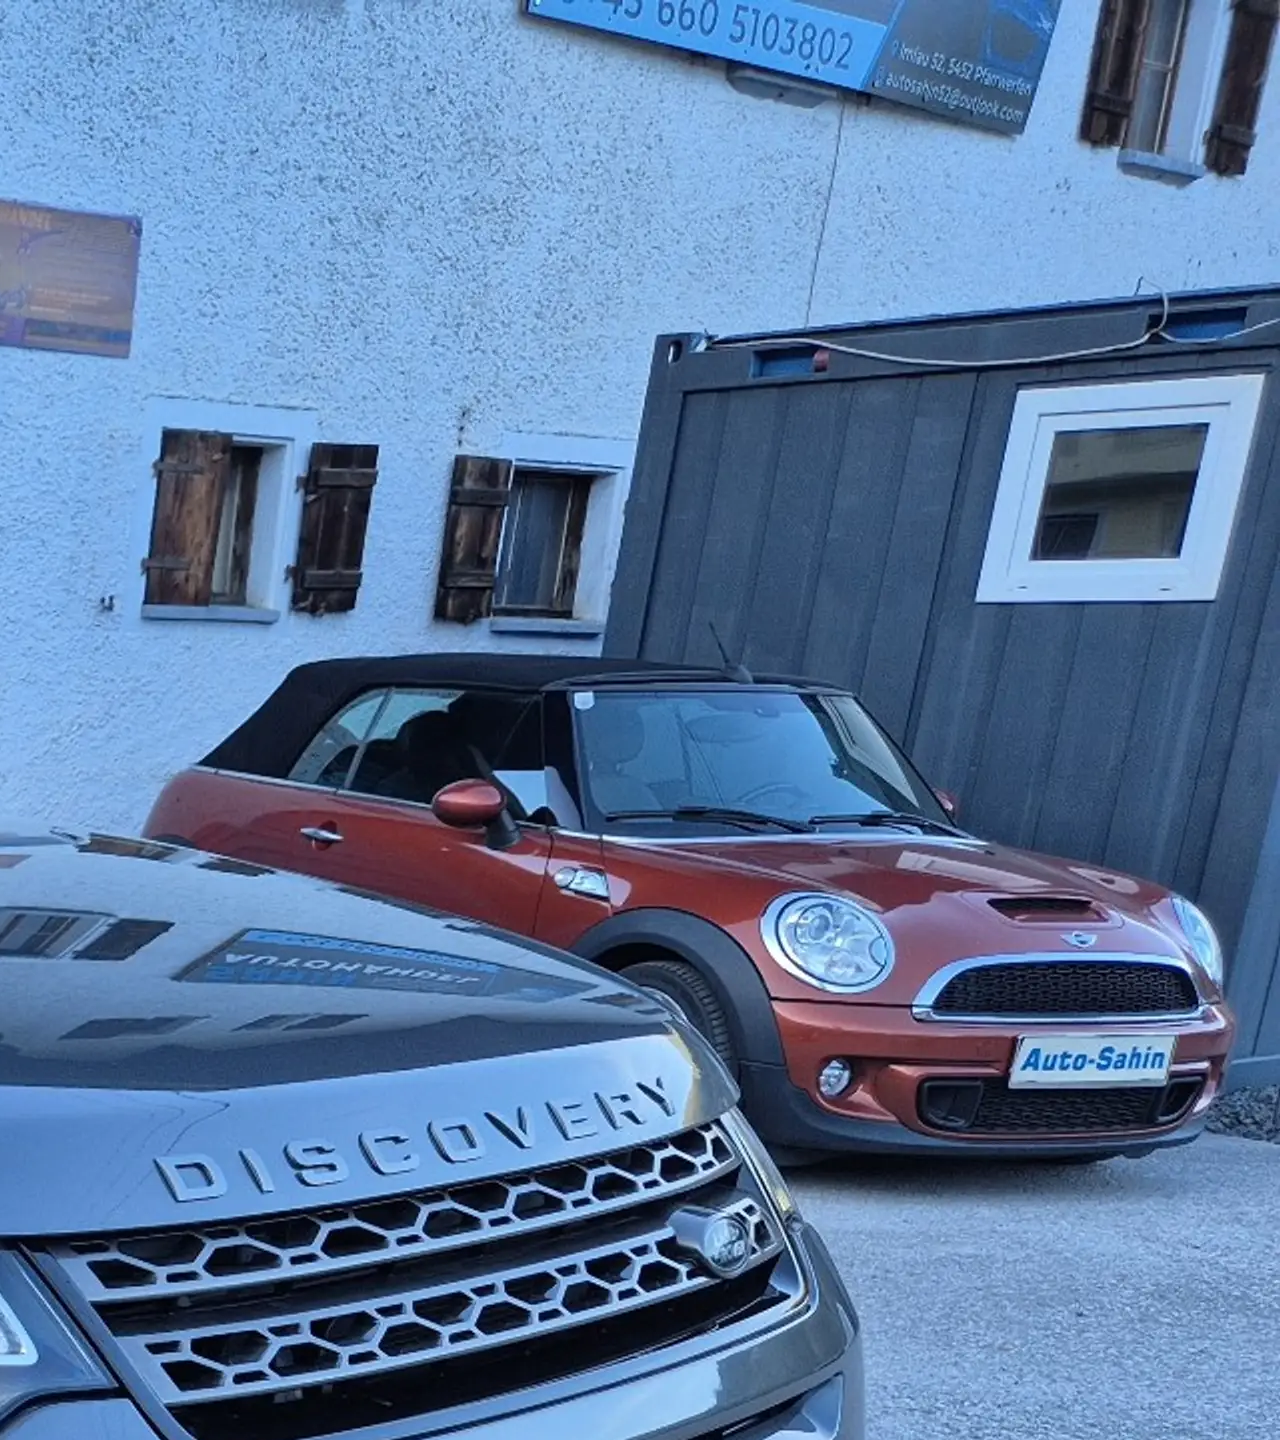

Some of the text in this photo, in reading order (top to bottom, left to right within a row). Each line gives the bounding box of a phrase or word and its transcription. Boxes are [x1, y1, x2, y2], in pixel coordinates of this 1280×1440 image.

[657, 0, 854, 70] 660 5103802
[1020, 1045, 1166, 1071] Auto-Sahin
[153, 1076, 677, 1203] DISCOVERY
